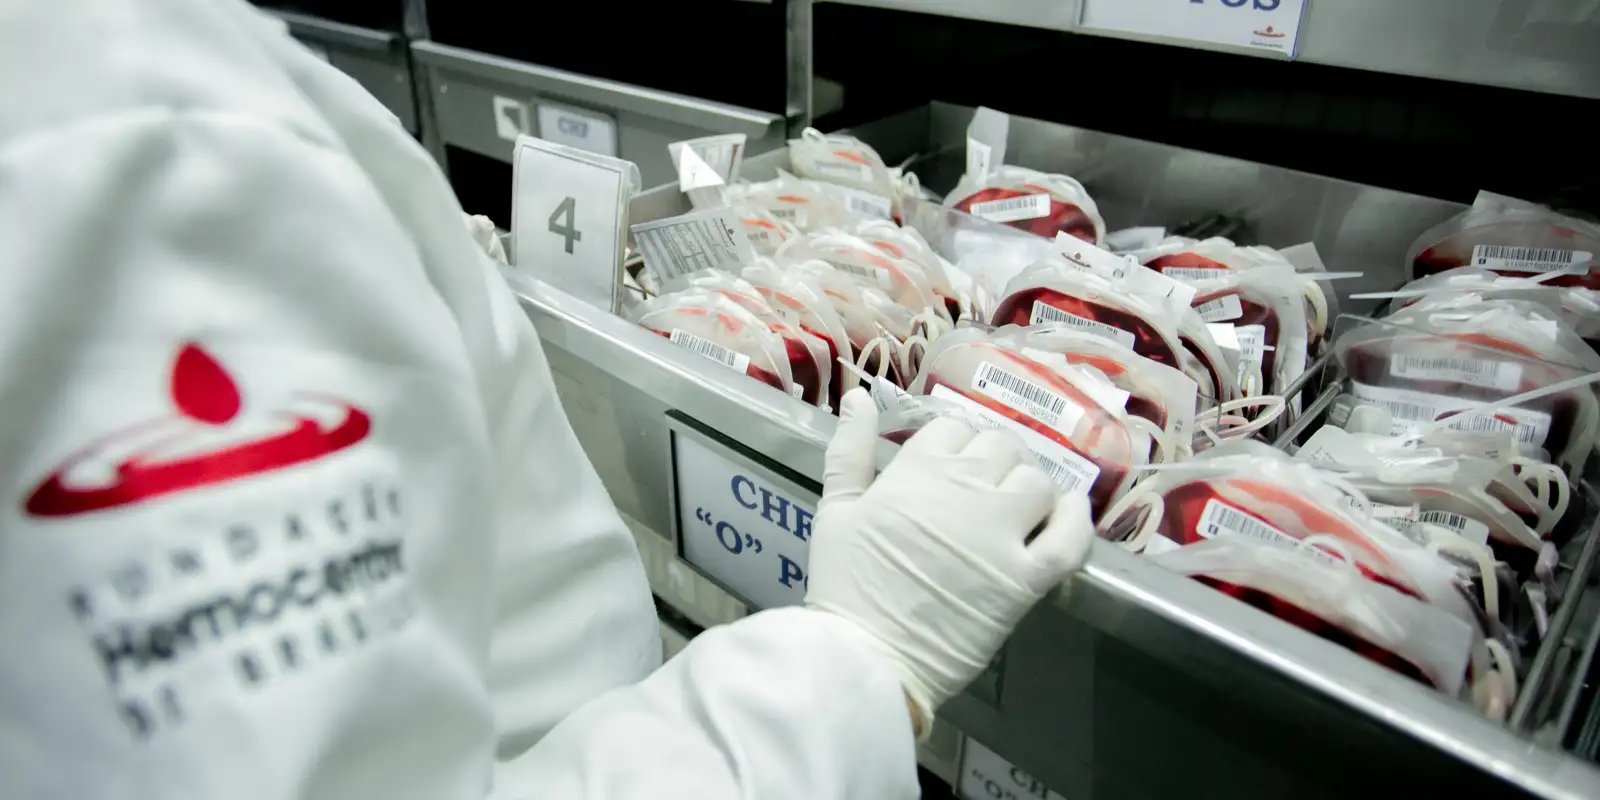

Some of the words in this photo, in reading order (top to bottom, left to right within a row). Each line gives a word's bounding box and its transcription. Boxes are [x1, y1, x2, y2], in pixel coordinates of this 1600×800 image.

[548, 196, 581, 254] 4
[731, 474, 814, 542] CHF
[778, 553, 808, 592] P
